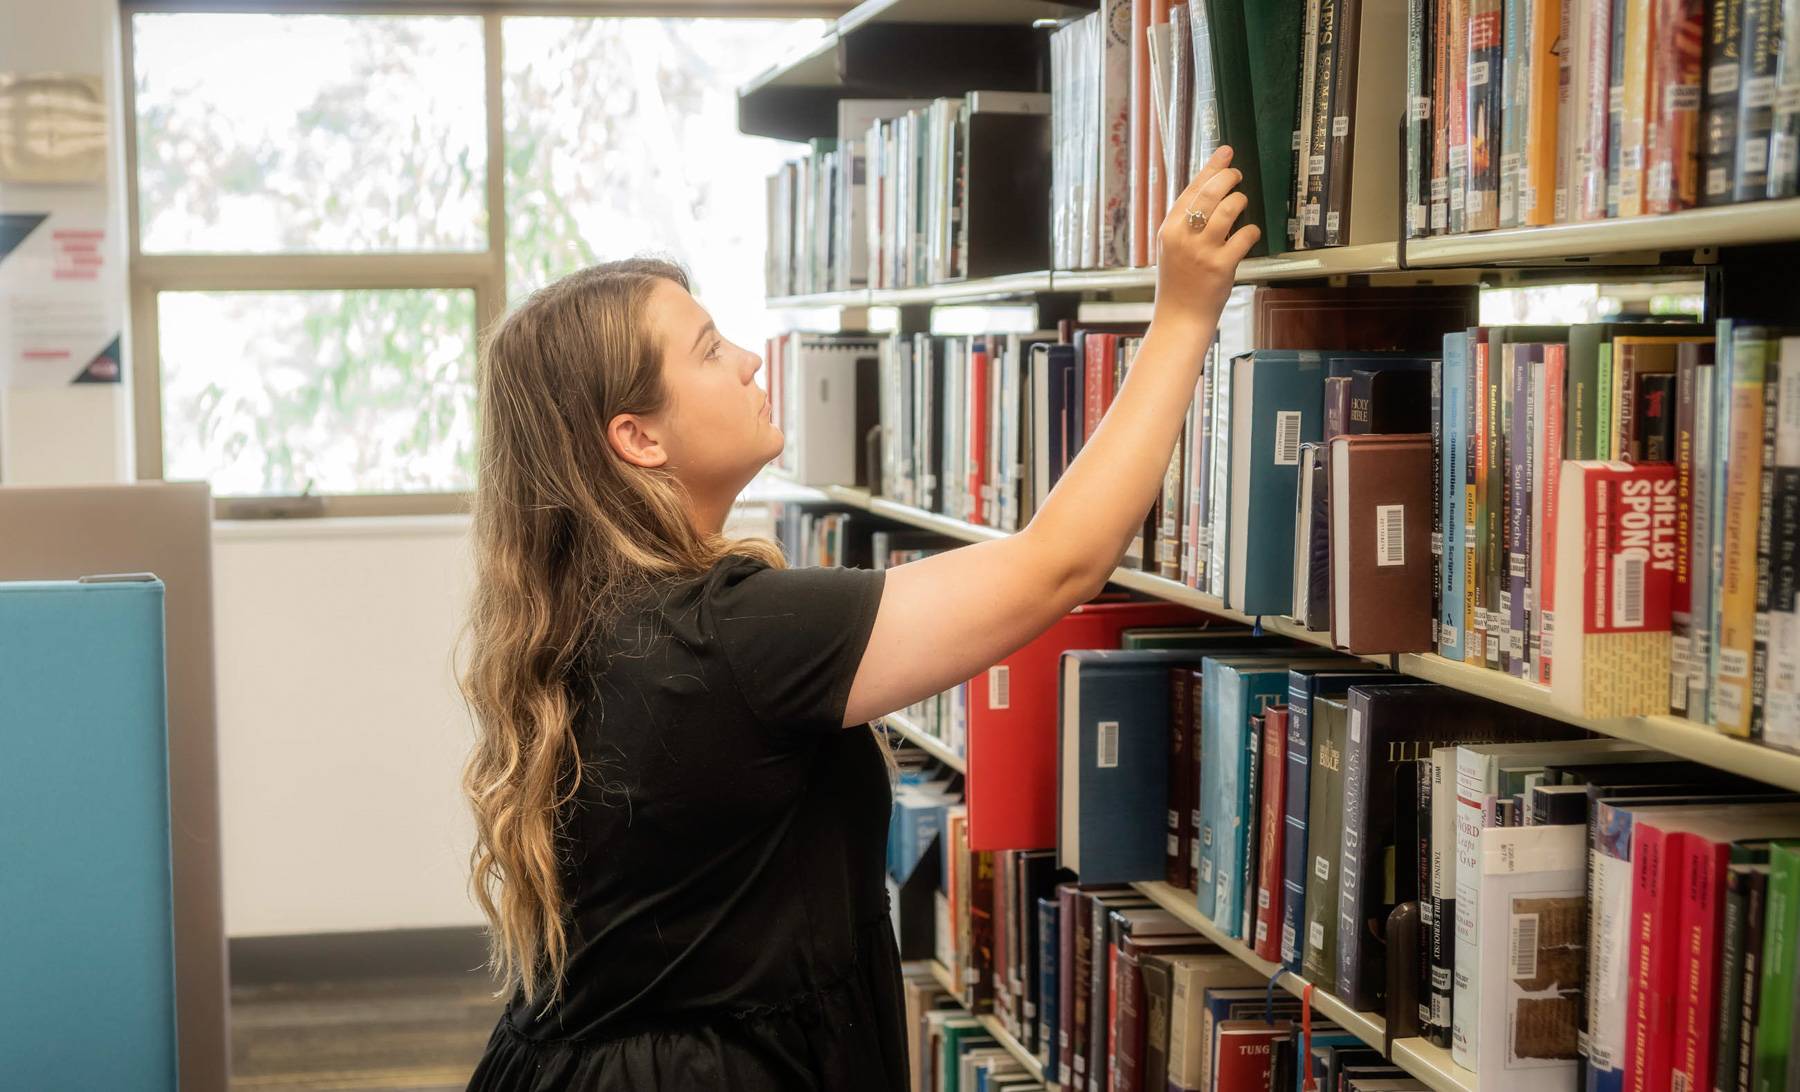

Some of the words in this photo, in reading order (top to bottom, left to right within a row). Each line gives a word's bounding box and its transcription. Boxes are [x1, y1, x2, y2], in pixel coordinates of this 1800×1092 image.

[1350, 410, 1368, 422] BIBLE
[1351, 398, 1369, 410] HOLY
[1621, 389, 1633, 424] Faith
[1449, 432, 1457, 499] Communities,
[1514, 463, 1523, 490] Soul
[1680, 430, 1691, 497] ABUSING
[1448, 502, 1456, 542] Reading
[1512, 508, 1522, 548] Psyche
[1652, 479, 1676, 571] SHELBY
[1678, 503, 1689, 584] SCRIPTURE
[1729, 490, 1745, 596] Interpretation
[1447, 545, 1455, 592] Scripture
[1319, 751, 1340, 771] BIBLE
[1340, 825, 1358, 937] BIBLE
[1433, 897, 1441, 919] BIBLE
[1642, 911, 1651, 943] THE
[1727, 903, 1737, 952] Biblical
[1432, 919, 1440, 960] SERIOUSLY
[1691, 926, 1702, 955] THE
[1639, 945, 1651, 990] BIBLE
[1689, 959, 1701, 1005] BIBLE
[1637, 992, 1647, 1018] and
[1687, 1007, 1698, 1036] and
